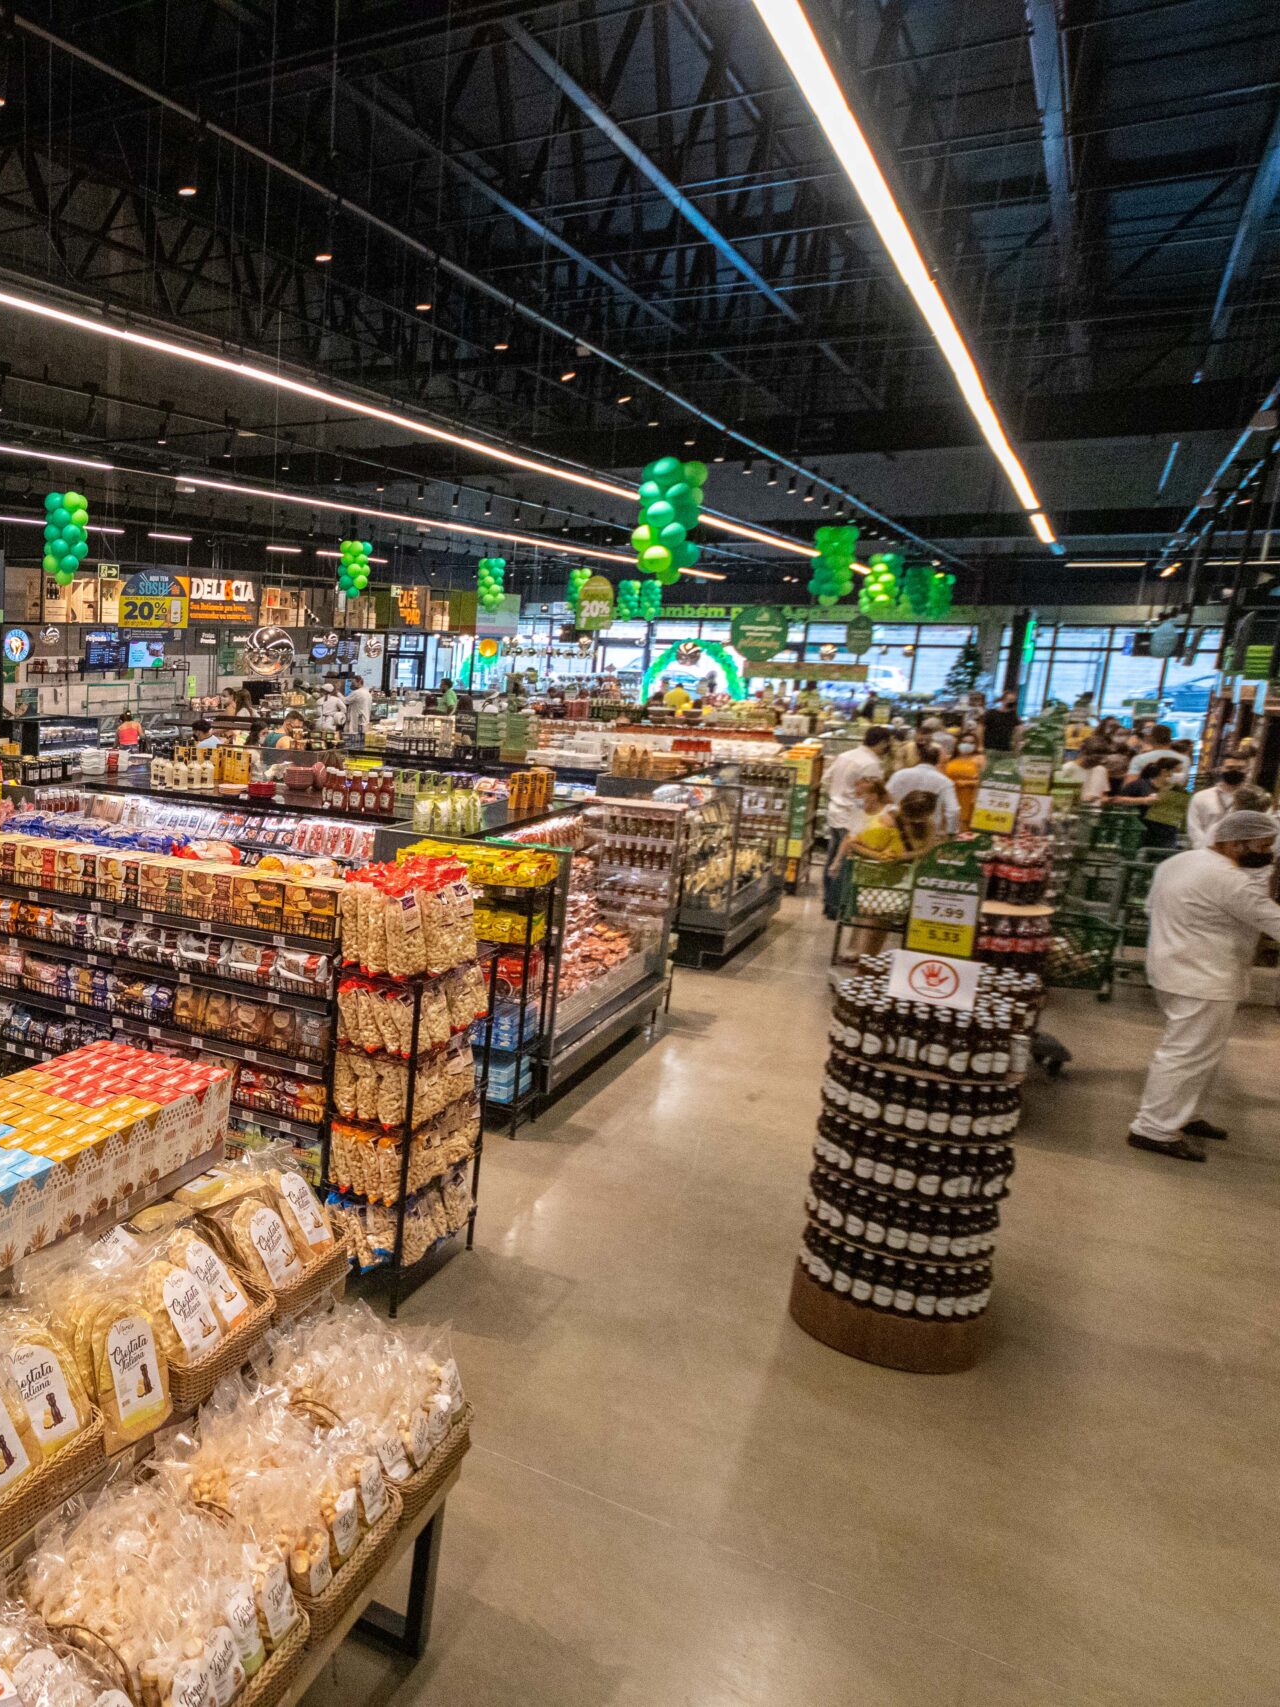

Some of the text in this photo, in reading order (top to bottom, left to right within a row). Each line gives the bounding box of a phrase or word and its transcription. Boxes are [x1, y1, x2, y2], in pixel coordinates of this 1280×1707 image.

[581, 600, 610, 618] 20%
[661, 604, 726, 618] ambém
[917, 876, 978, 891] OFERTA
[110, 1334, 149, 1366] Crostata
